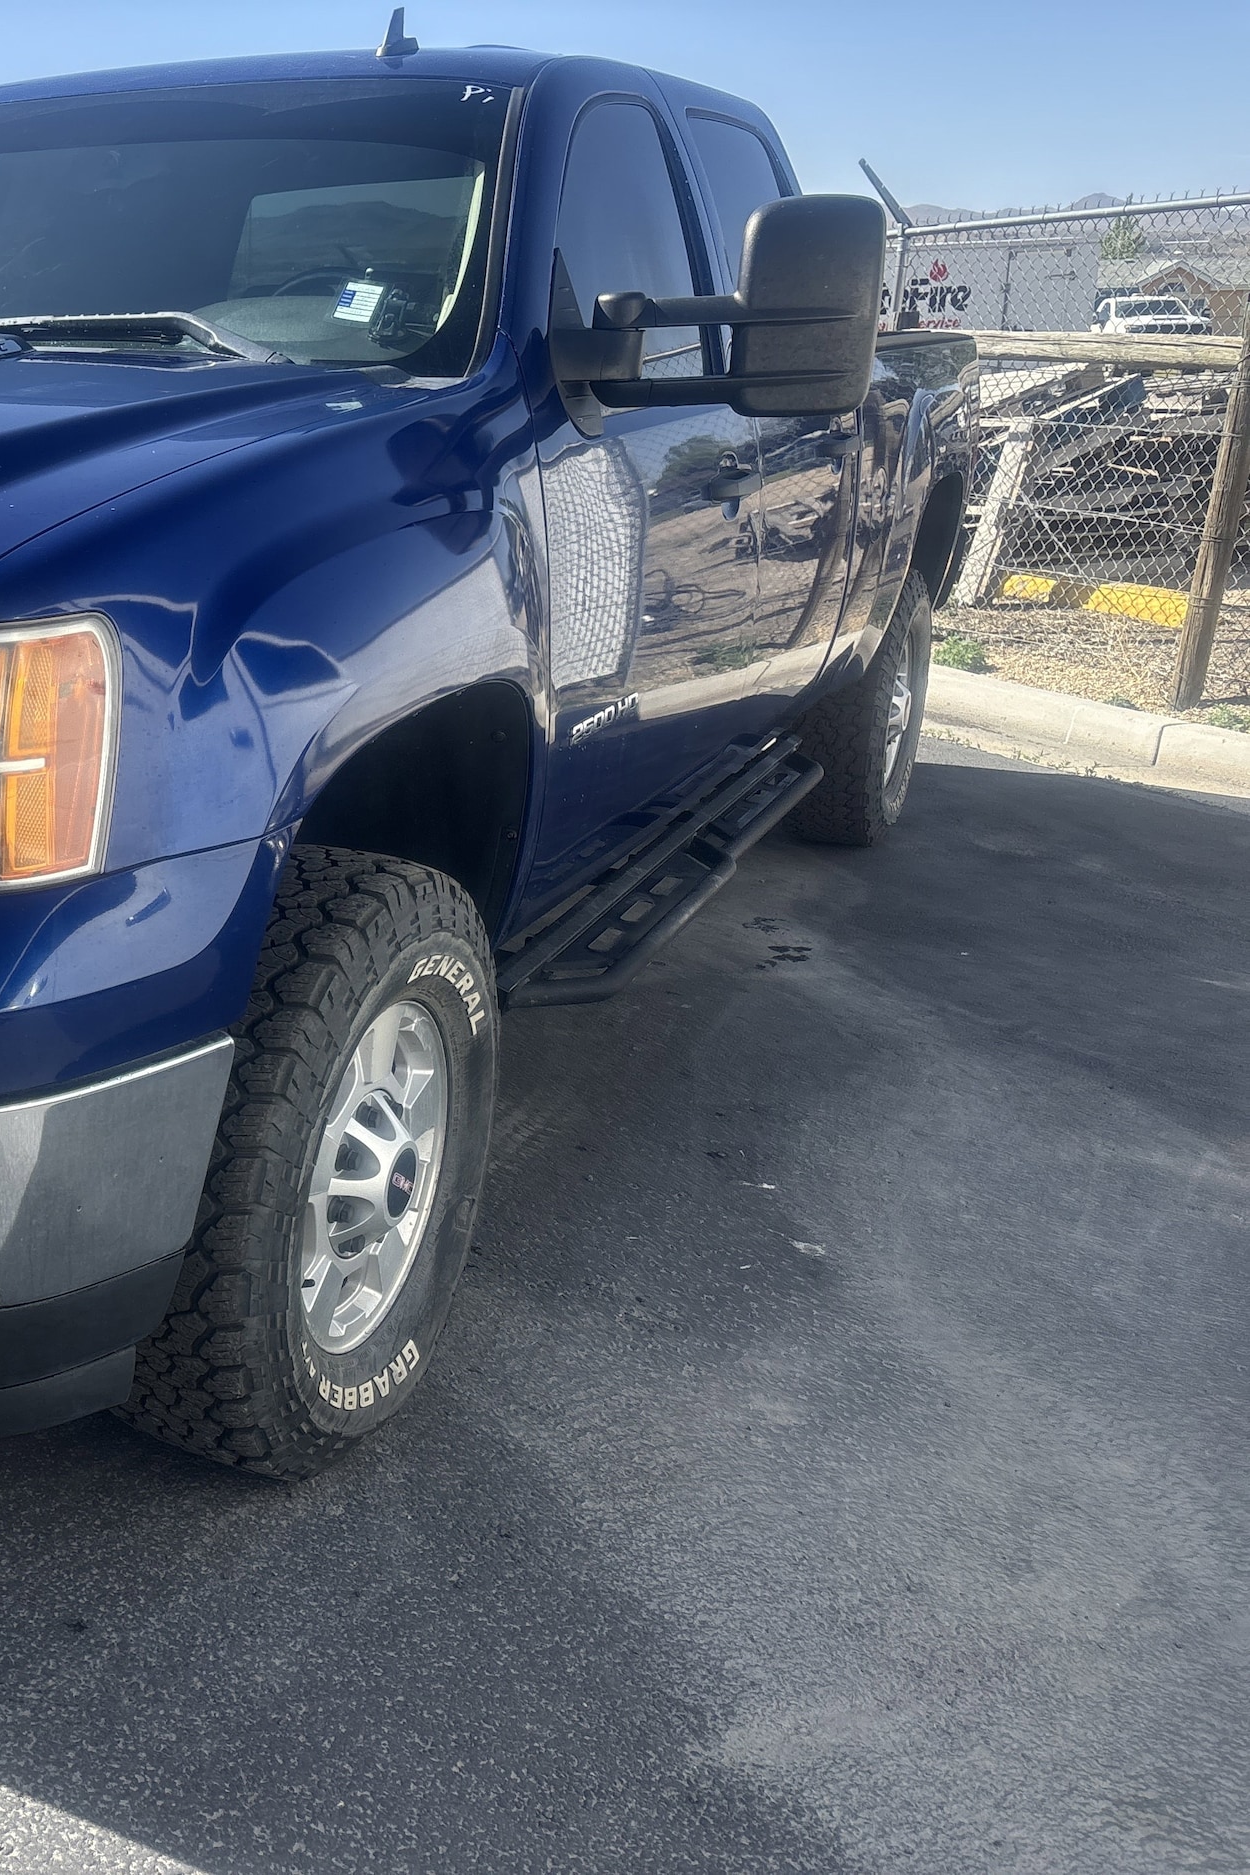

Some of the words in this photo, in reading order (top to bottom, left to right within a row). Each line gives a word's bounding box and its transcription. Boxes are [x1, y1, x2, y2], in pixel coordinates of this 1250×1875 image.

[570, 705, 616, 746] 2500
[616, 691, 640, 720] HD
[406, 953, 486, 1036] GENERAL
[391, 1171, 415, 1196] GMC
[318, 1338, 421, 1411] GRABBER
